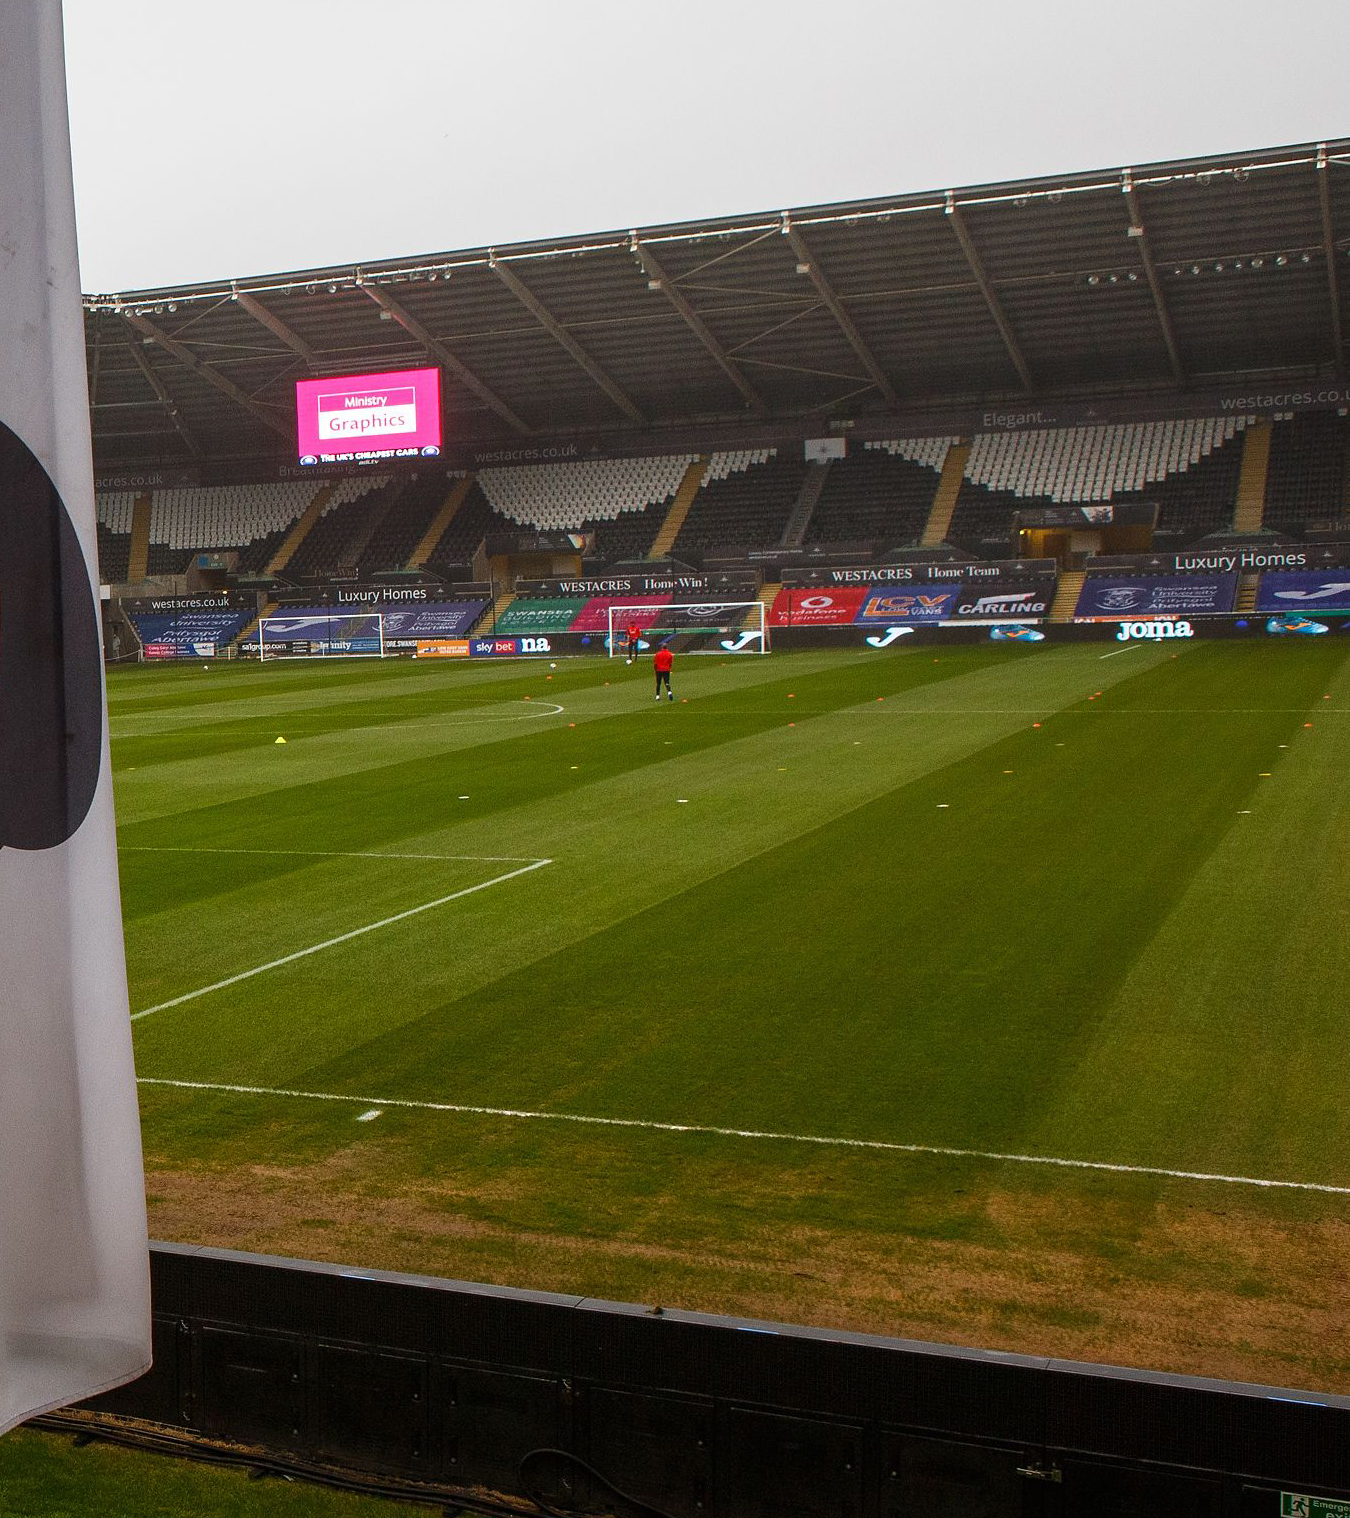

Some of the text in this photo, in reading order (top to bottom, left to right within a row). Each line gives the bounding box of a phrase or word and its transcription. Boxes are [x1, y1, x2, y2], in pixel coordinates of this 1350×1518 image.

[344, 396, 388, 408] Ministry
[329, 413, 406, 433] Graphics
[320, 453, 335, 463] THE
[355, 449, 395, 460] CHEAPEST
[396, 447, 419, 457] CARS
[474, 444, 578, 464] westacres.co.uk
[1175, 553, 1307, 571] Luxury Homes
[832, 565, 1000, 582] WESTACRES Home Team
[560, 579, 631, 592] WESTACRES
[151, 596, 230, 610] westacres.co.uk
[338, 588, 427, 604] Luxury Homes
[910, 608, 944, 616] VANS
[958, 601, 1047, 614] CARLING
[476, 642, 492, 653] sky
[495, 641, 512, 651] bet
[1313, 1499, 1350, 1512] Emerge
